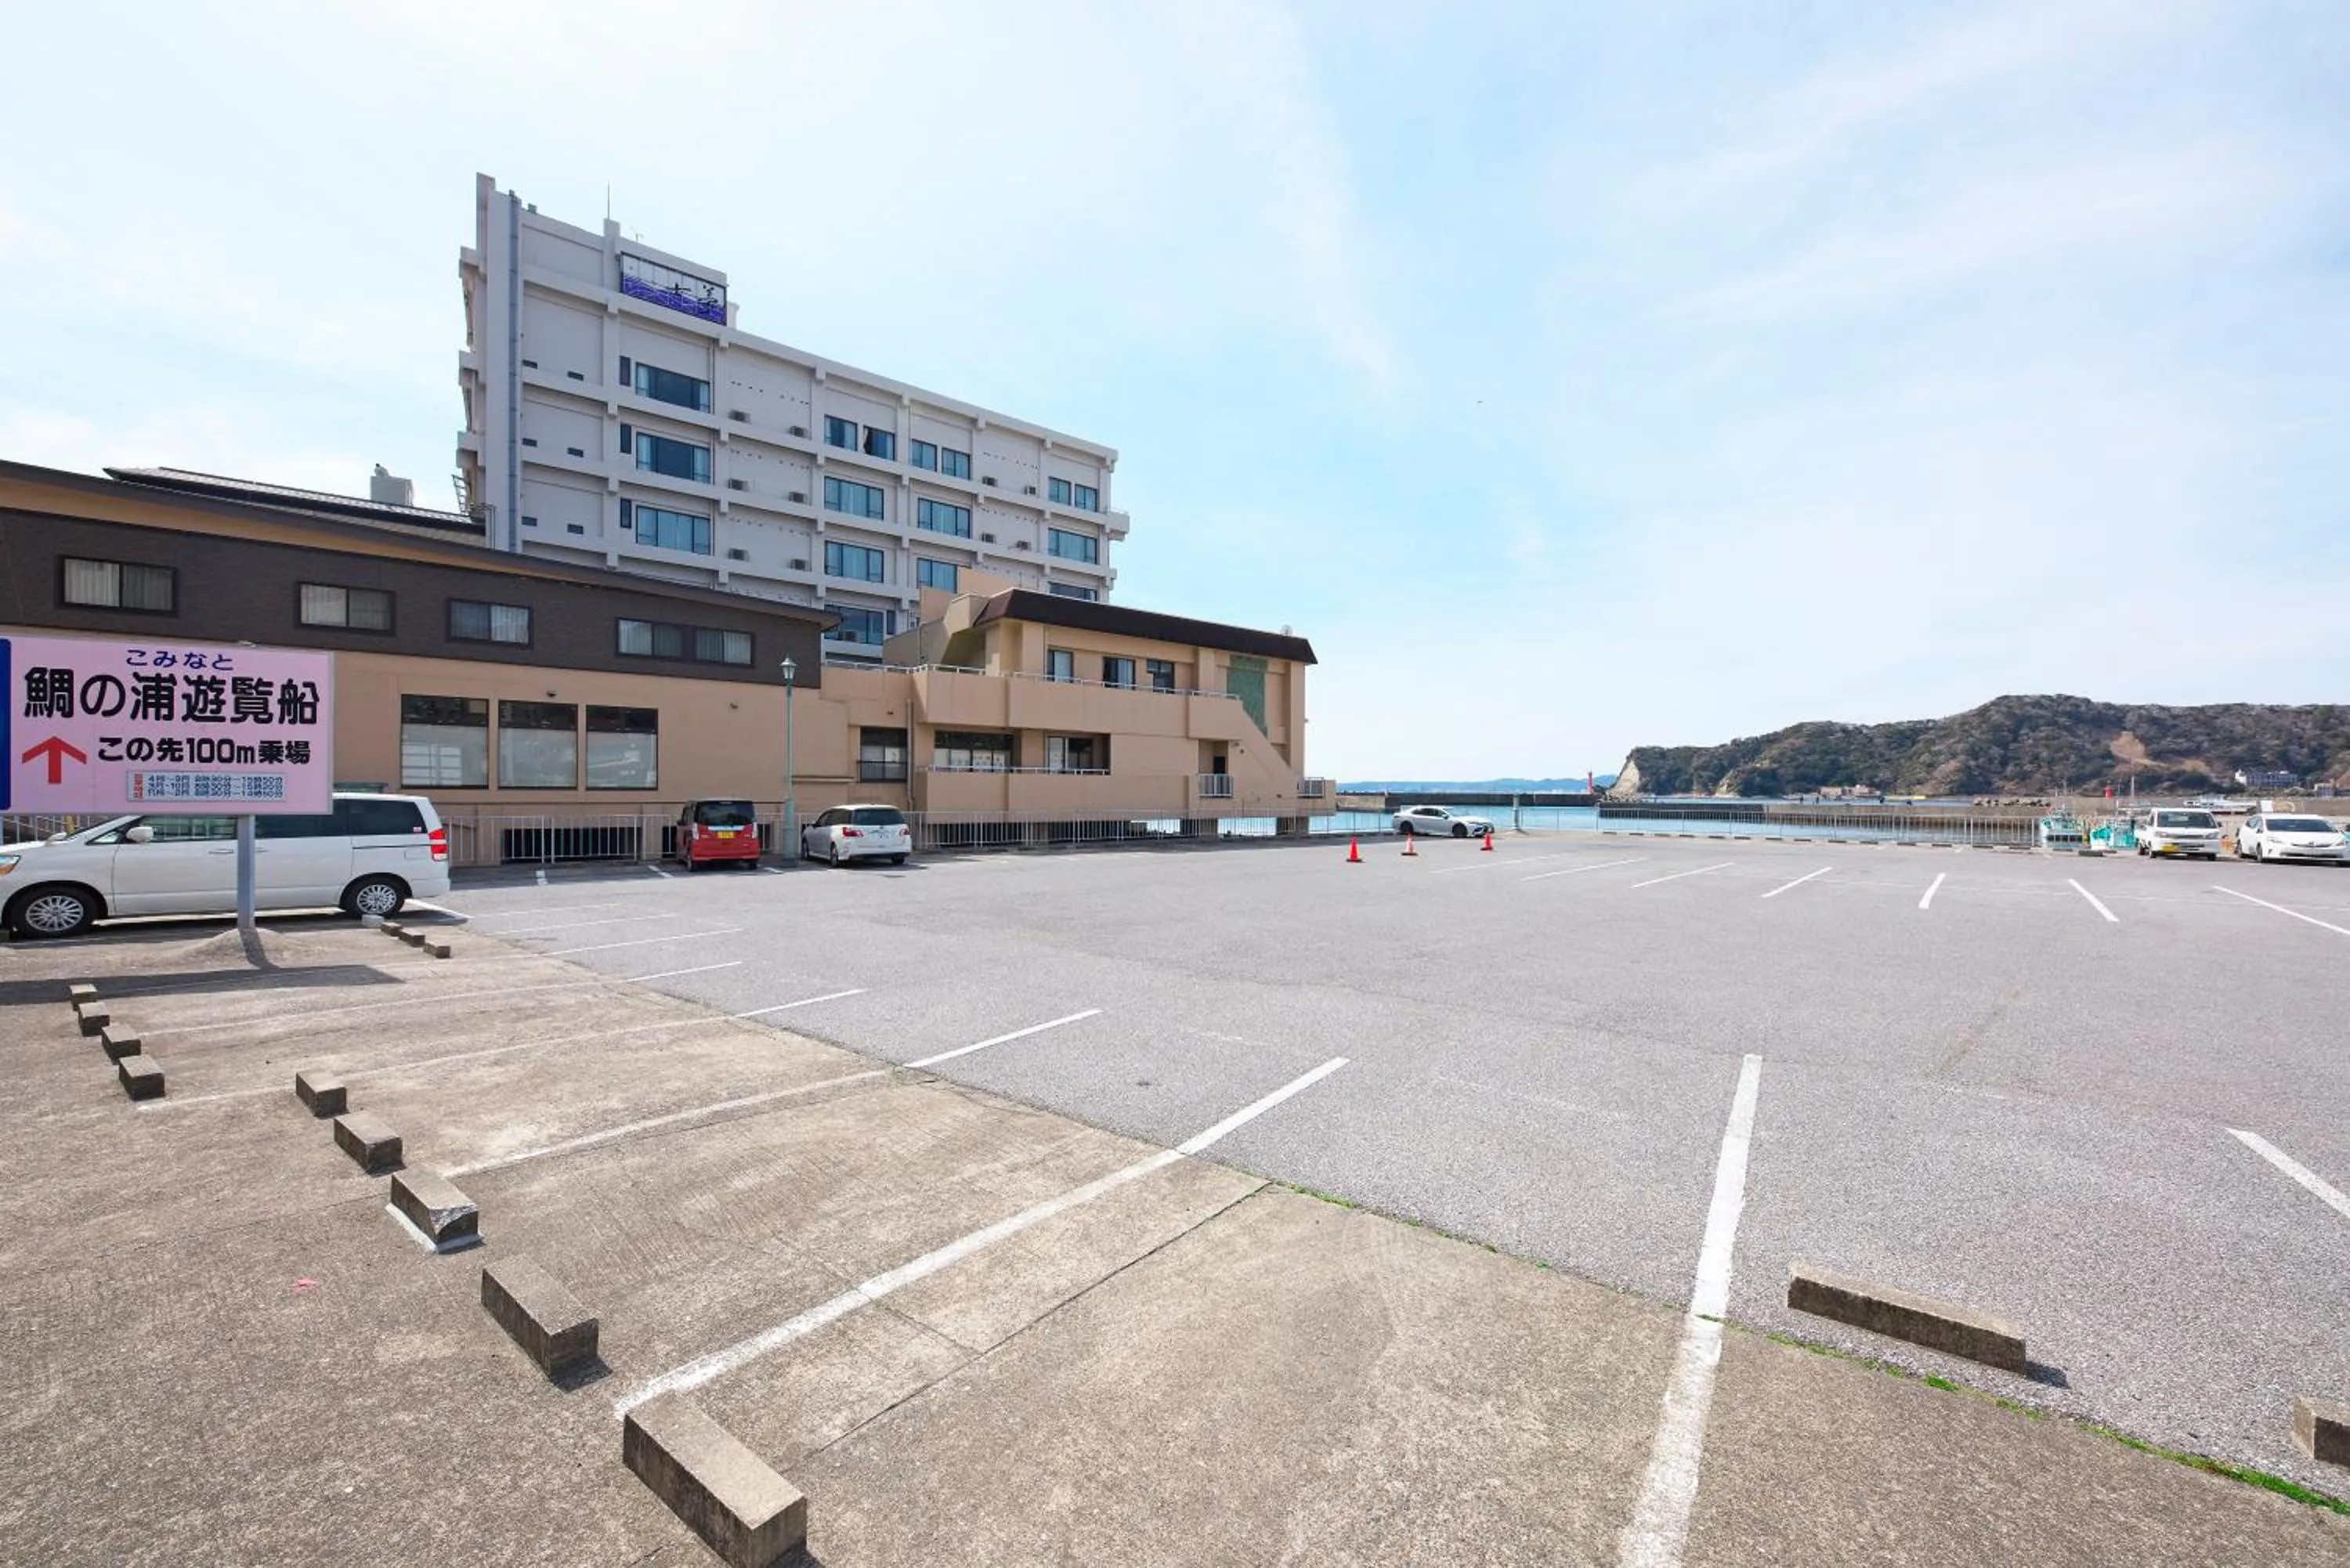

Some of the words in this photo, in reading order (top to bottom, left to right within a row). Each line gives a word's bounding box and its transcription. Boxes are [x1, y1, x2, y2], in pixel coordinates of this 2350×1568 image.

[126, 649, 234, 671] こみなと
[24, 666, 320, 725] 鯛の浦遊覧船
[98, 737, 311, 765] この先100m乗場
